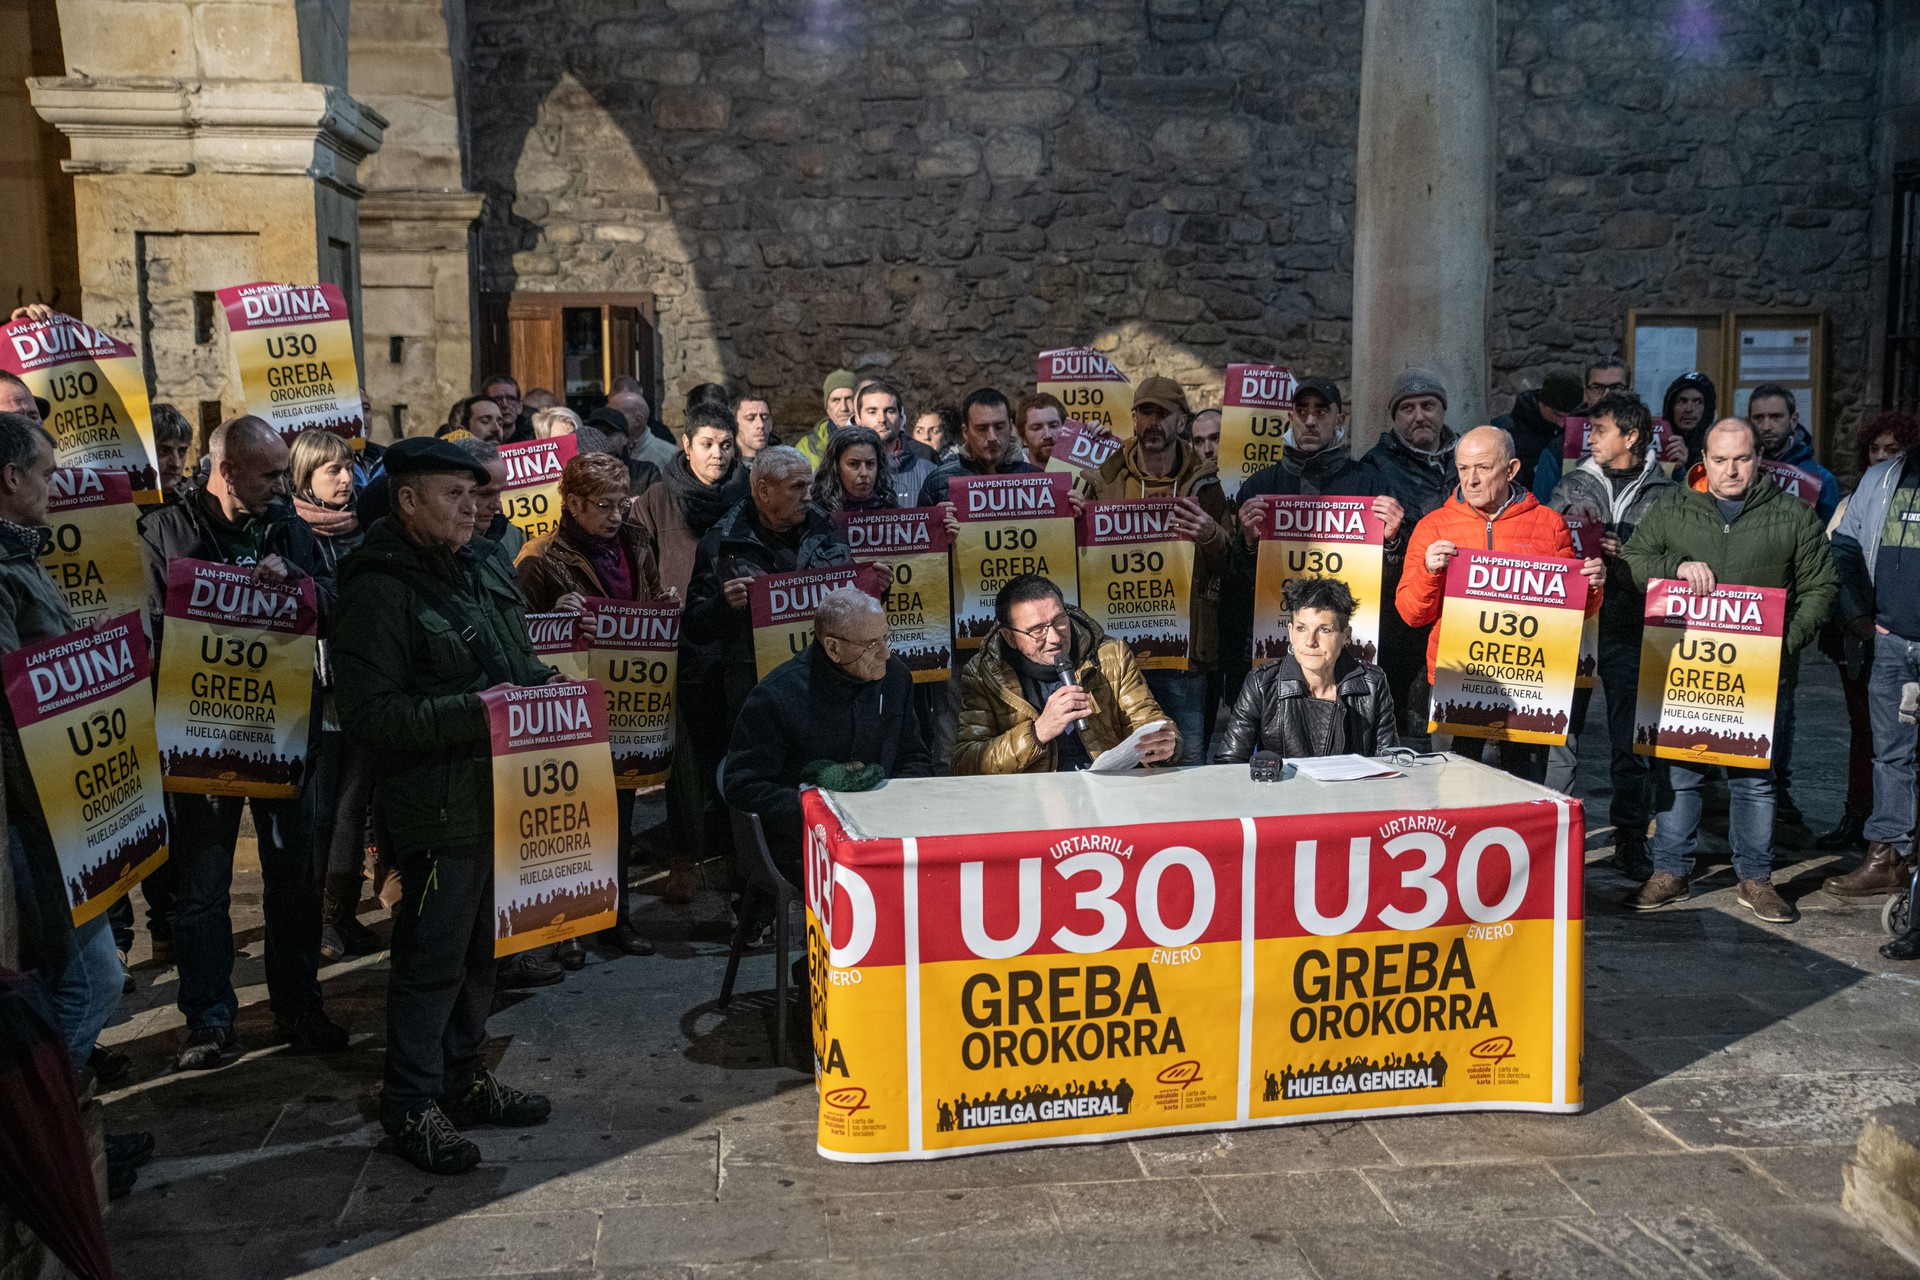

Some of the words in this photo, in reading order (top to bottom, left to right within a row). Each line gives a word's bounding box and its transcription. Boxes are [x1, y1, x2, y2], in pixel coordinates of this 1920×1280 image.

[241, 290, 331, 319] DUINA
[11, 325, 115, 362] DUINA
[266, 334, 317, 359] U30
[267, 361, 333, 387] GREBA
[1051, 357, 1119, 375] DUINA
[49, 371, 98, 402] U30
[270, 383, 335, 403] OROKORRA
[1063, 388, 1104, 406] U30
[54, 403, 117, 435] GREBA
[272, 407, 303, 419] HUELGA
[305, 402, 339, 415] GENERAL
[58, 427, 120, 452] OROKORRA
[84, 449, 124, 463] GENERAL
[968, 478, 1054, 489] LAN-PENTSIO-BIZITZA
[79, 494, 105, 504] SOCIAL
[968, 486, 1056, 512] DUINA
[1275, 501, 1365, 510] LAN-PENTSIO-BIZITZA
[848, 513, 930, 525] LAN-PENTSIO-BIZITZA
[968, 511, 997, 519] SOBERANÍA
[1275, 509, 1366, 534] DUINA
[848, 522, 931, 547] DUINA
[984, 528, 1037, 551] U30
[980, 556, 1050, 578] GREBA
[1111, 551, 1164, 574] U30
[1288, 550, 1343, 574] U30
[1471, 555, 1568, 573] LAN-PENTSIO-BIZITZA
[769, 570, 858, 589] LAN-PENTSIO-BIZITZA
[1107, 578, 1176, 601] GREBA
[1468, 564, 1567, 598] DUINA
[190, 578, 298, 620] DUINA
[1107, 600, 1176, 615] OROKORRA
[1465, 589, 1497, 598] SOBERANÍA
[1521, 595, 1543, 603] CAMBIO
[1543, 597, 1565, 605] SOCIAL
[1665, 594, 1763, 625] DUINA
[187, 608, 223, 620] SOBERANÍA
[273, 620, 295, 629] SOCIAL
[771, 612, 801, 622] SOBERANÍA
[1107, 620, 1141, 630] HUELGA
[1142, 619, 1178, 629] GENERAL
[1479, 610, 1538, 638] U30
[1718, 622, 1740, 630] CAMBIO
[26, 625, 129, 667] LAN-PENTSIO-BIZITZA
[201, 635, 267, 669] U30
[1469, 641, 1546, 668] GREBA
[1679, 638, 1737, 664] U30
[29, 639, 135, 703] DUINA
[609, 660, 668, 684] U30
[1466, 663, 1544, 683] OROKORRA
[1670, 667, 1746, 694] GREBA
[38, 696, 76, 714] SOBERANÍA
[76, 690, 92, 704] PARA
[92, 687, 100, 698] EL
[101, 679, 121, 692] CAMBIO
[191, 672, 276, 705] GREBA
[505, 685, 588, 702] LAN-PENTSIO-BIZITZA
[1462, 683, 1498, 695] HUELGA
[1500, 688, 1543, 700] GENERAL
[1667, 688, 1745, 708] OROKORRA
[190, 700, 275, 723] OROKORRA
[509, 698, 592, 737] DUINA
[609, 713, 670, 728] ROKORRA
[1663, 708, 1700, 720] HUELGA
[1702, 712, 1745, 725] GENERAL
[67, 708, 126, 756] U30
[186, 726, 227, 740] HUELGA
[229, 730, 276, 744] GENERAL
[509, 737, 534, 748] SOBERANÍA
[535, 736, 549, 744] PARA
[556, 733, 576, 742] CAMBIO
[576, 731, 592, 740] SOCIAL
[75, 745, 140, 800] GREBA
[523, 760, 579, 798] U30
[82, 775, 142, 822] OROKORRA
[86, 823, 119, 848] HUELGA
[119, 803, 146, 831] GENERAL
[520, 801, 591, 839] GREBA
[1379, 815, 1457, 840] URTARRILA
[520, 831, 591, 861] OROKORRA
[1049, 835, 1134, 860] URTARRILA
[520, 867, 552, 886] HUELGA
[555, 860, 593, 879] GENERAL
[1293, 826, 1530, 937] U30
[960, 845, 1216, 960] U30
[1467, 922, 1514, 941] ENERO
[1150, 946, 1201, 966] ENERO
[1293, 937, 1476, 1004] GREBA
[961, 962, 1162, 1029] GREBA
[1290, 992, 1498, 1043] OROKORRA
[961, 1016, 1186, 1071] OROKORRA
[1287, 1074, 1357, 1098] HUELGA
[1359, 1068, 1438, 1091] GENERAL
[963, 1102, 1037, 1128] HUELGA
[1039, 1095, 1123, 1120] GENERAL
